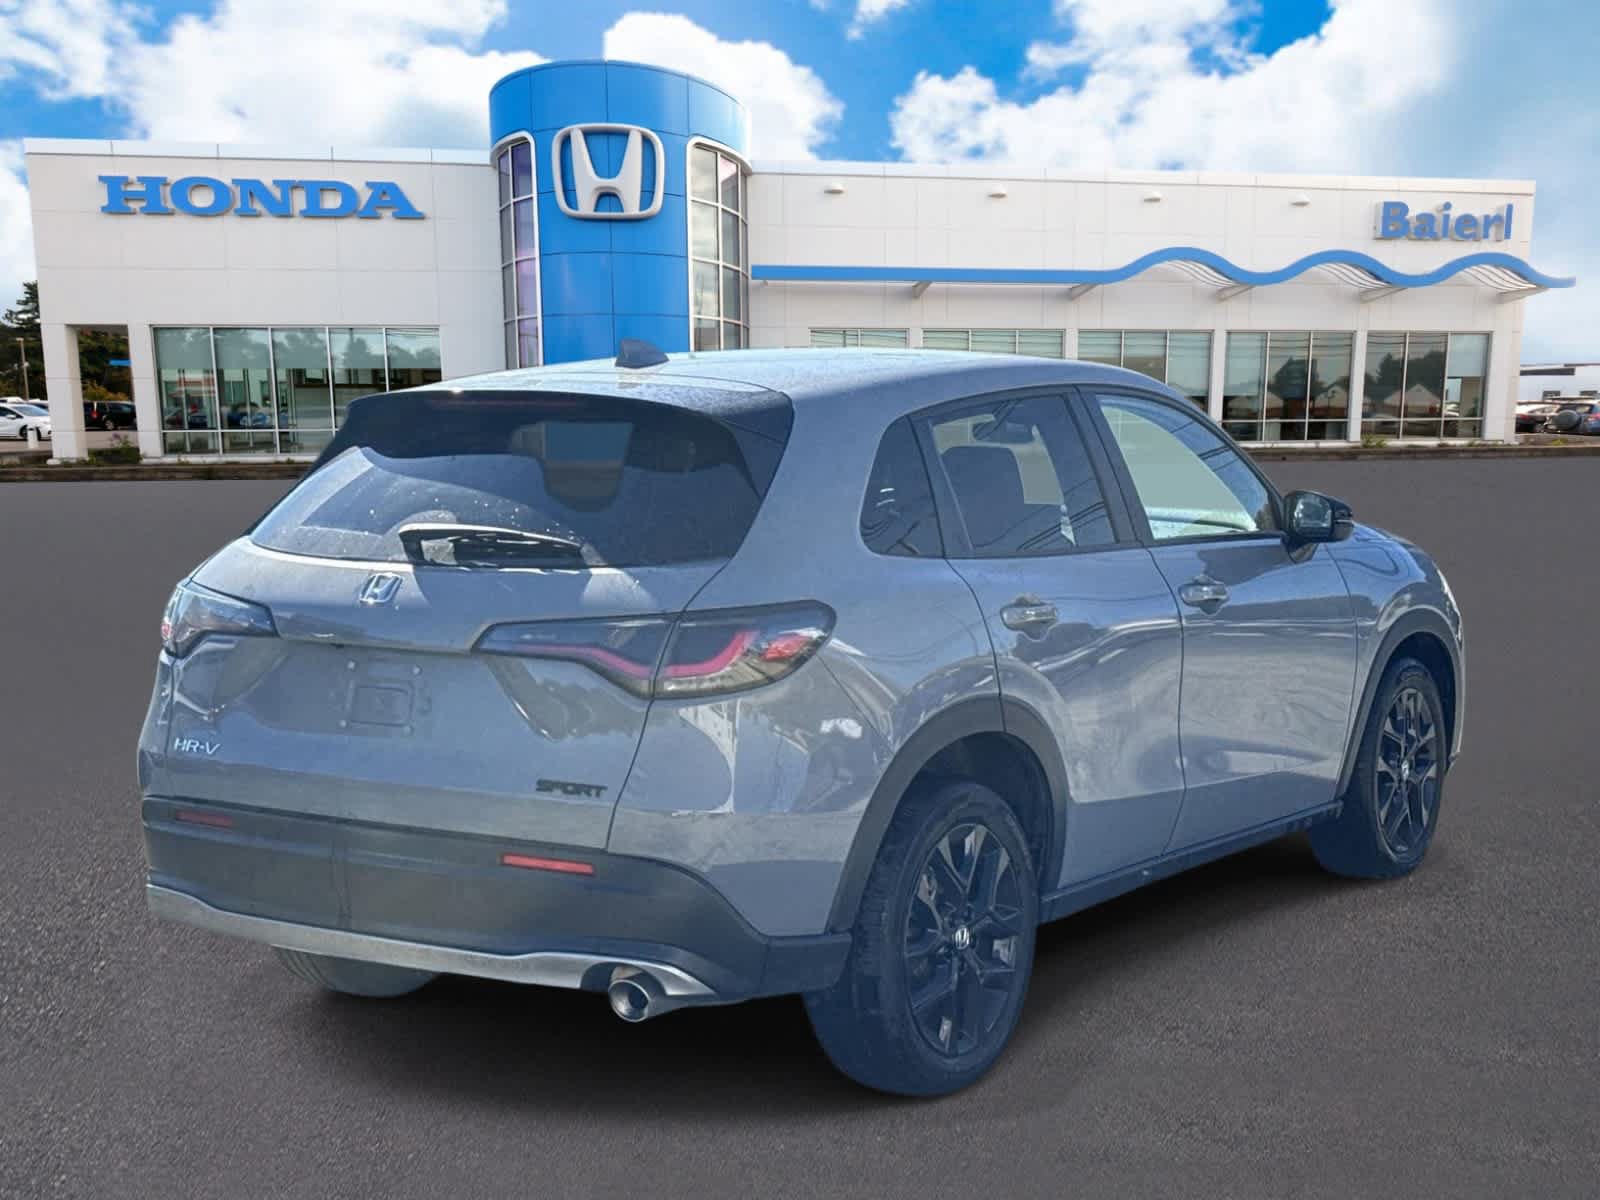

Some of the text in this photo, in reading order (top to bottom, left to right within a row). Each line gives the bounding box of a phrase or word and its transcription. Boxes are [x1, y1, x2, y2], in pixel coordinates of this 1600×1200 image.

[98, 175, 426, 219] HONDA
[1379, 201, 1515, 240] Baierl
[173, 737, 221, 755] HR-V
[536, 778, 608, 798] SPORT
